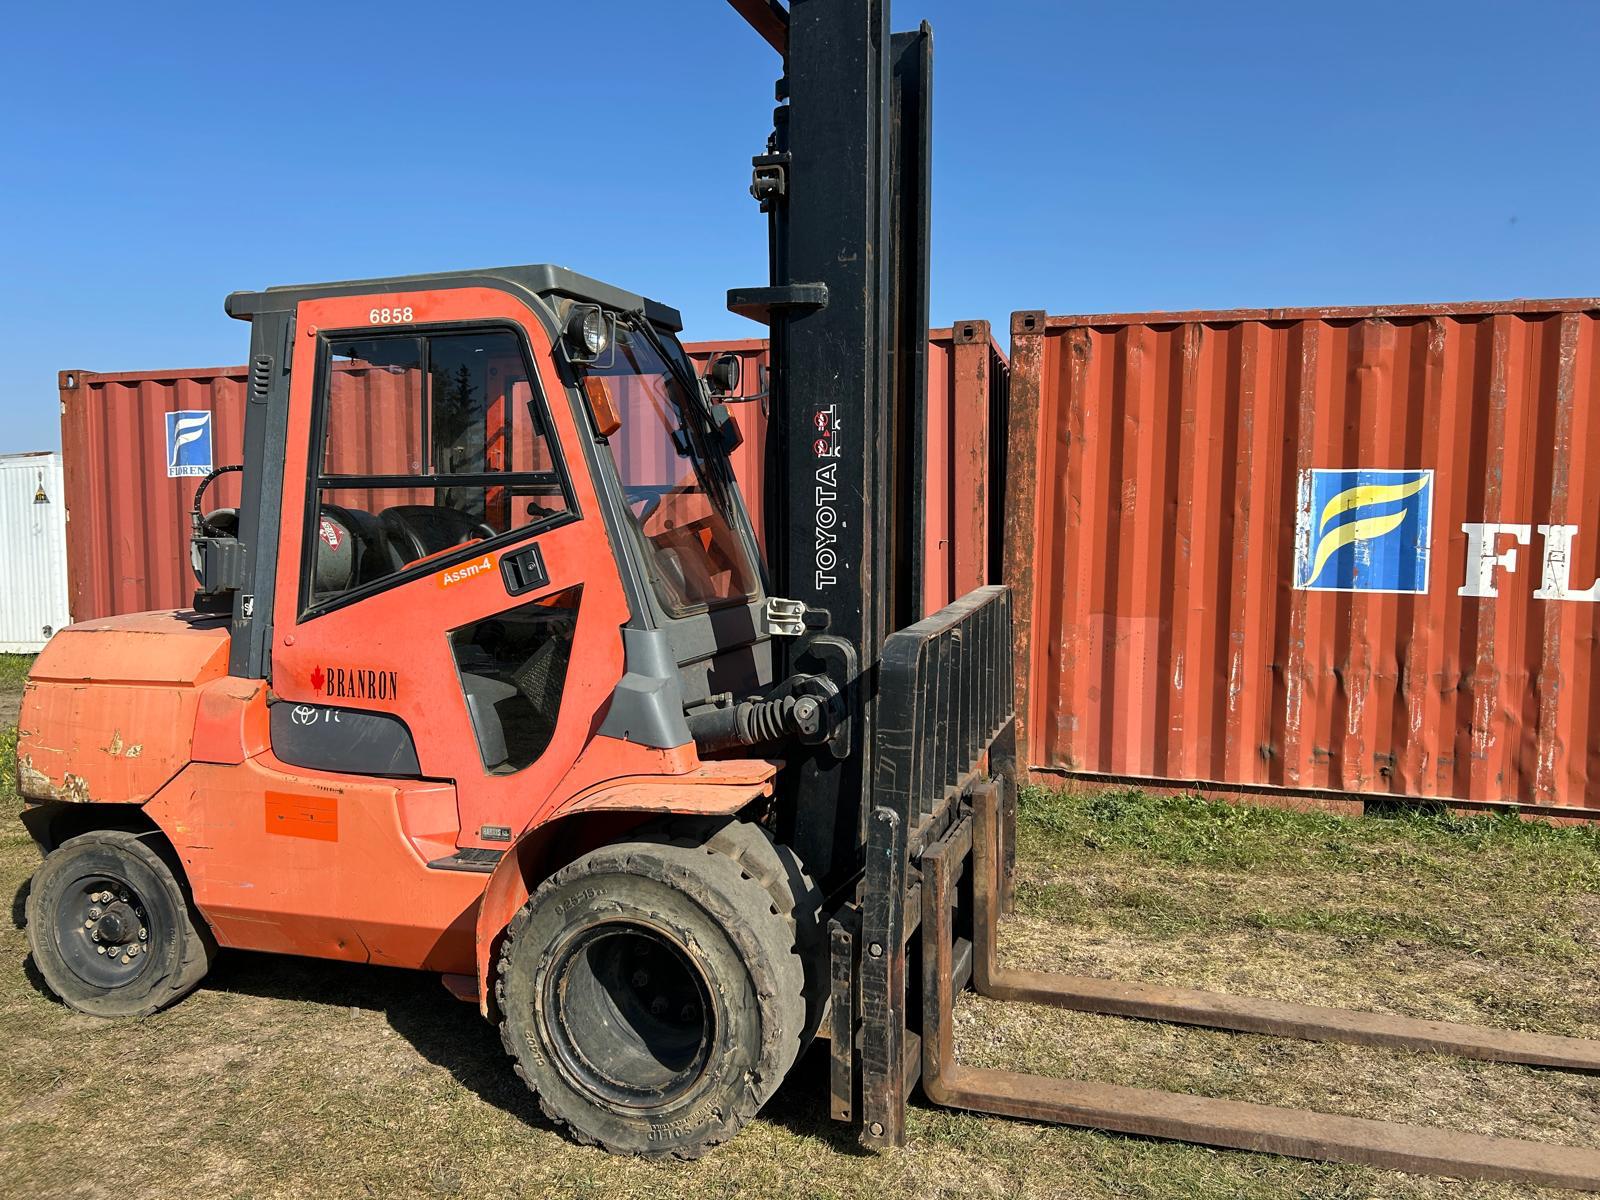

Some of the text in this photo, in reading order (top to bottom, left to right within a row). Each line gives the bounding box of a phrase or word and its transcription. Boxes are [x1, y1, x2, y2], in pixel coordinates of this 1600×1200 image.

[369, 305, 414, 325] 6858
[815, 462, 837, 591] TOYOTA
[443, 557, 492, 586] Assm-4
[1457, 522, 1600, 602] FL
[326, 667, 398, 701] BRANRON
